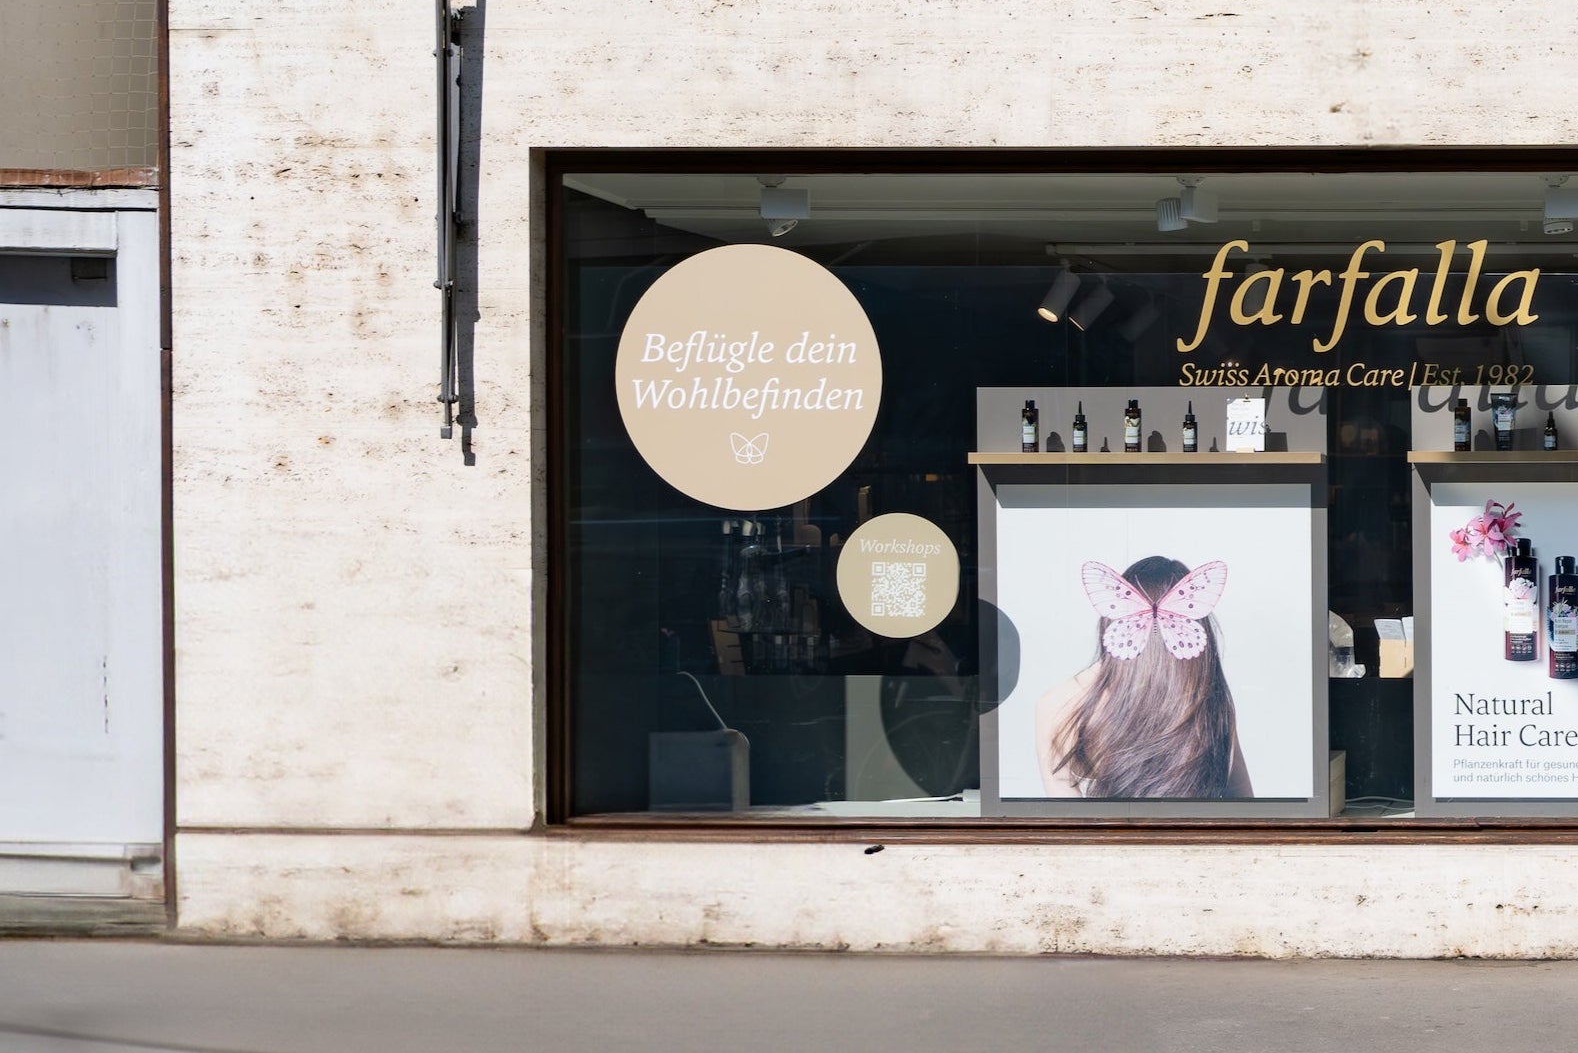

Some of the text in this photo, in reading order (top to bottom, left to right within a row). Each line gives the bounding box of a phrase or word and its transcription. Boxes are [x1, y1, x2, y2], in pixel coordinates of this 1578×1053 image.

[1177, 239, 1541, 353] farfalla
[641, 330, 858, 373] Beflügle dein
[1179, 363, 1249, 387] Swiss
[1252, 363, 1340, 387] Aroma
[1347, 363, 1405, 386] Care
[1422, 364, 1464, 386] Est.
[1473, 364, 1534, 386] 1982
[632, 377, 864, 420] Wohlbefinden
[859, 538, 942, 558] Workshops
[1453, 691, 1553, 715] Natural
[1453, 723, 1578, 747] Hair Care
[1453, 759, 1523, 770] Pflanzenkraft
[1525, 759, 1541, 770] für
[1453, 773, 1474, 782] und
[1476, 772, 1523, 782] natürlich
[1525, 772, 1570, 782] schönes
